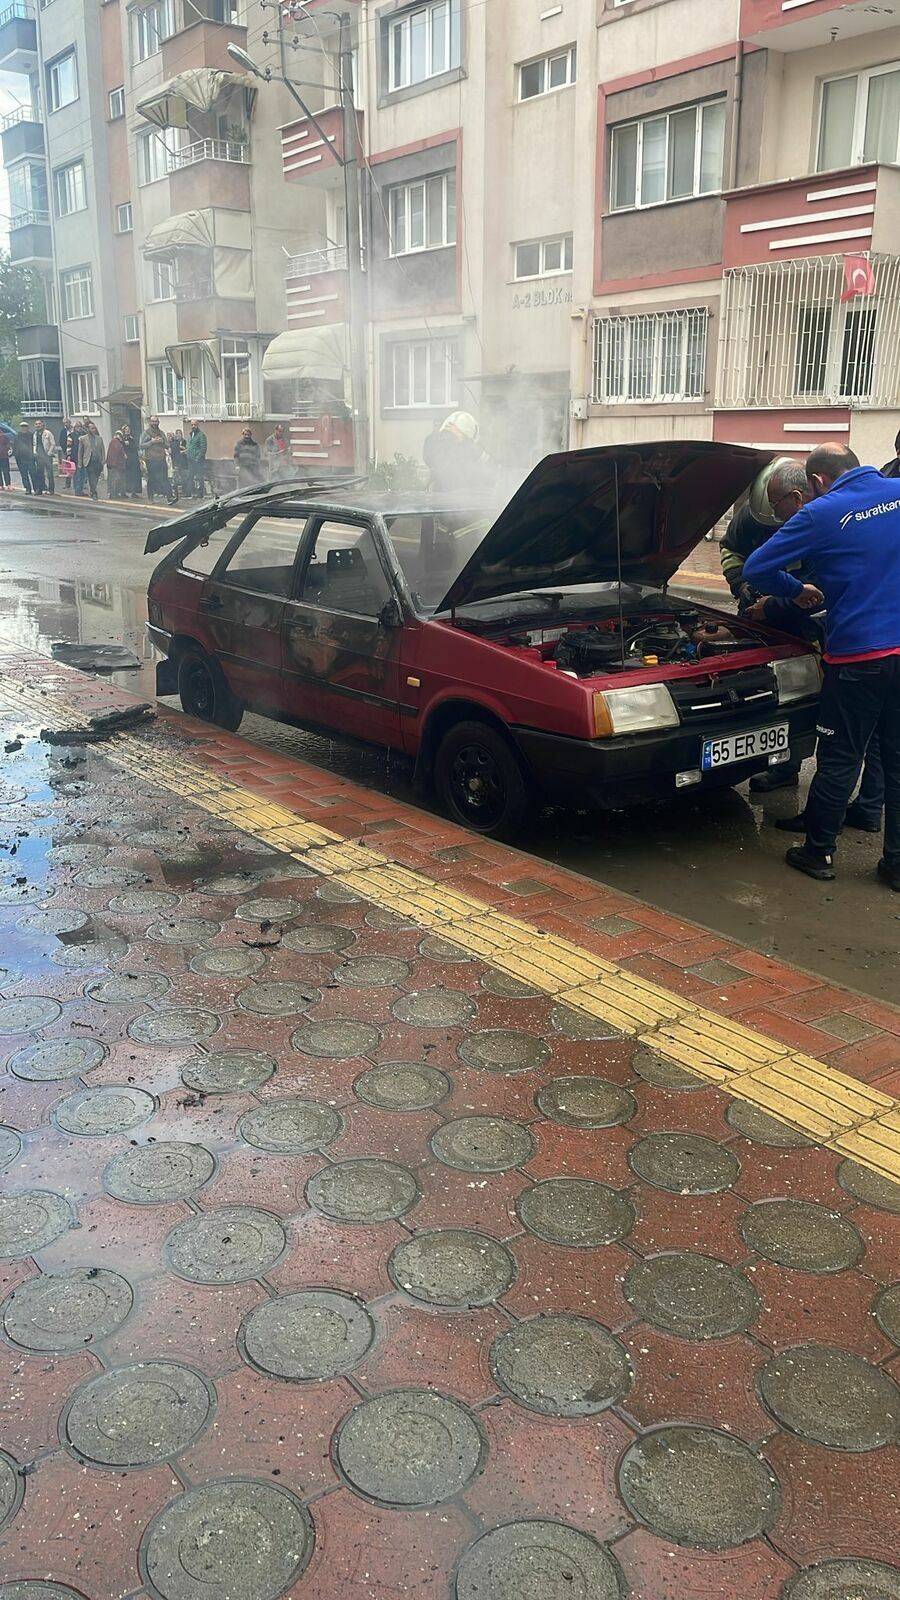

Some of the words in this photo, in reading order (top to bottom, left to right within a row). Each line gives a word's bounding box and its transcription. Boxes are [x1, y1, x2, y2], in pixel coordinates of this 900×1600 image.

[512, 293, 531, 309] A-2
[533, 288, 562, 306] BLOK
[855, 500, 900, 521] suratkar
[712, 740, 730, 763] 55
[735, 734, 755, 758] ER
[760, 727, 785, 751] 996
